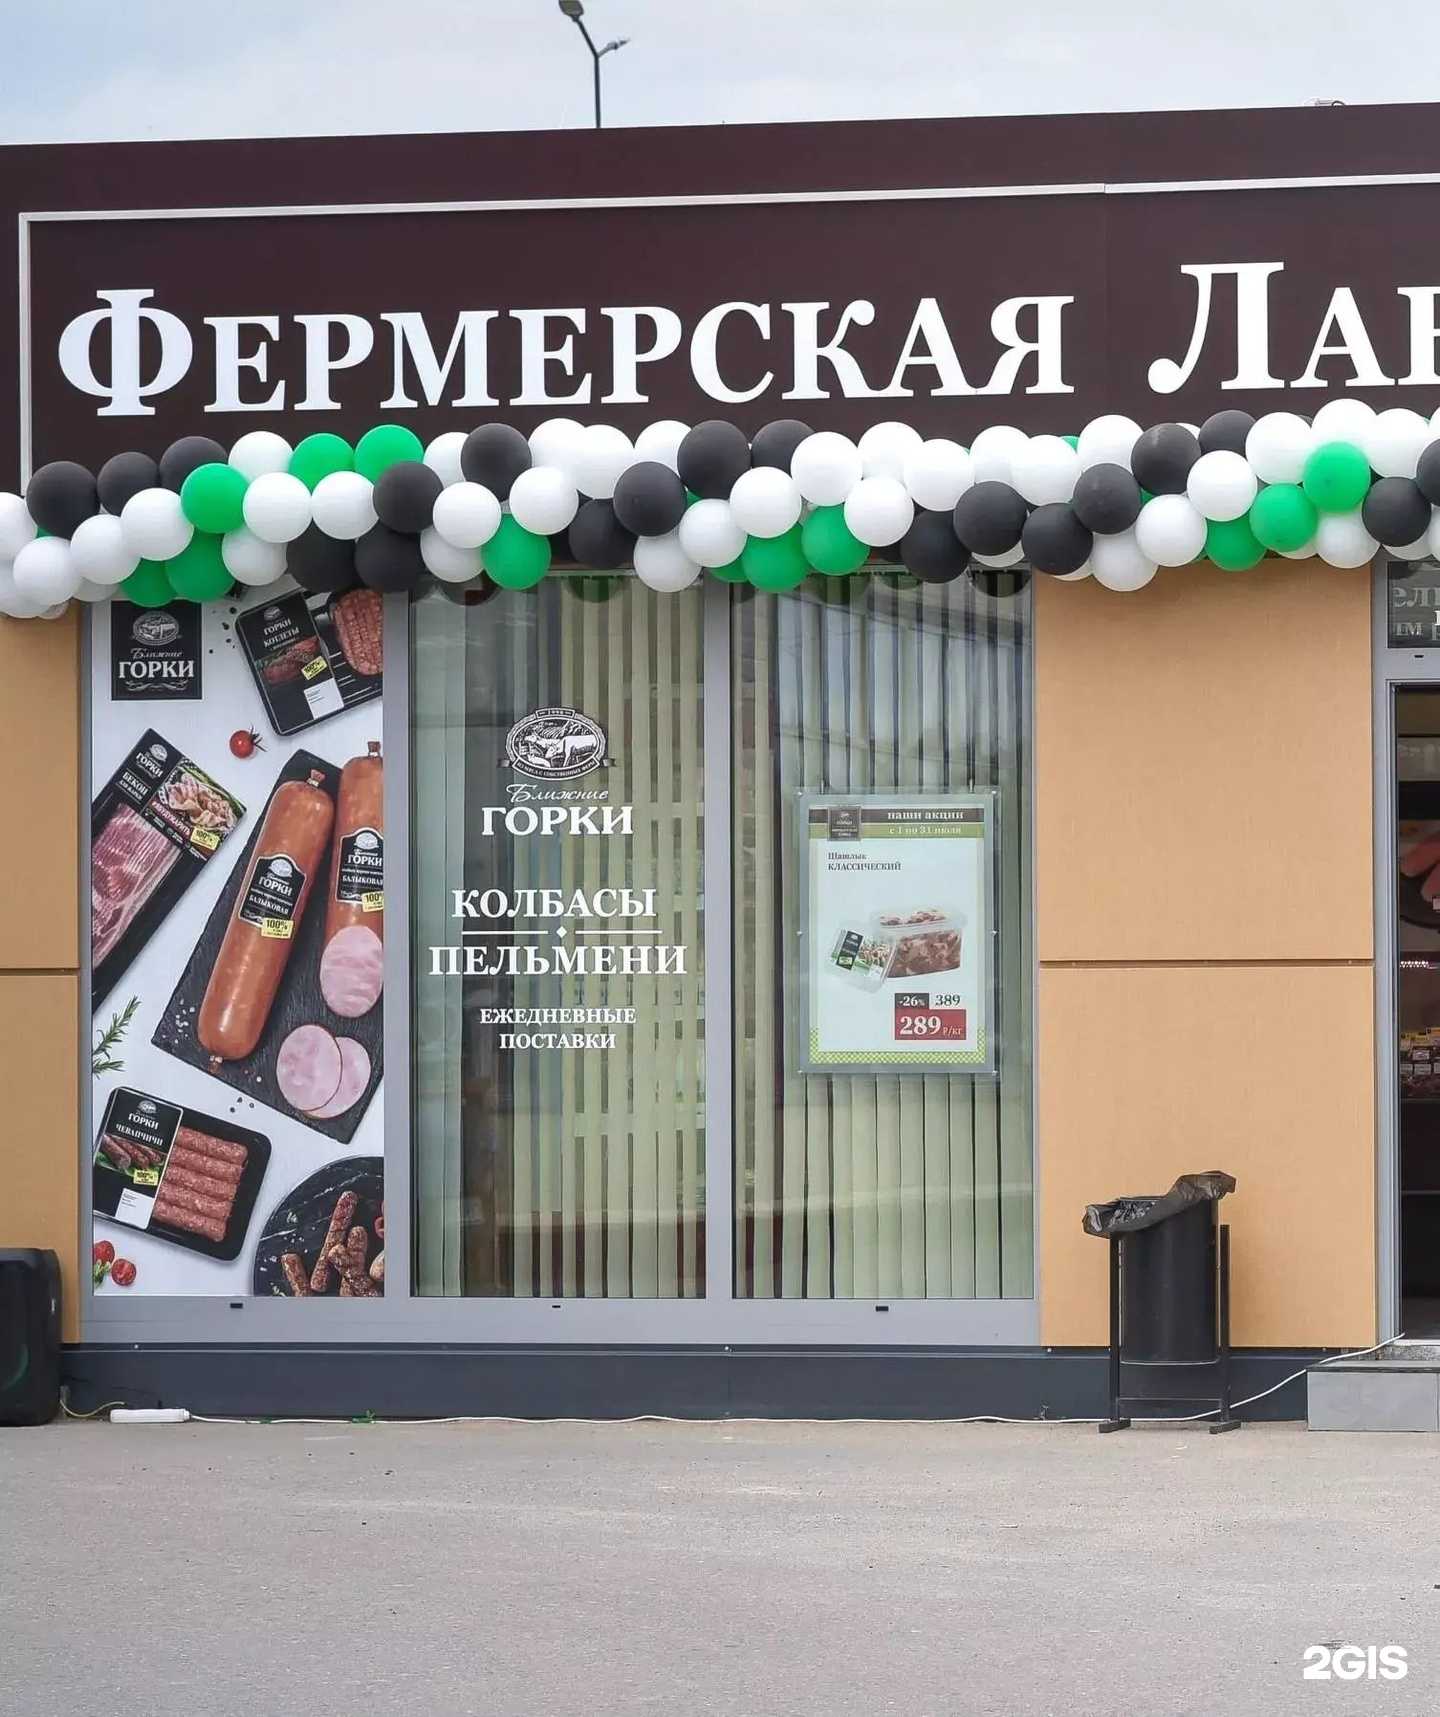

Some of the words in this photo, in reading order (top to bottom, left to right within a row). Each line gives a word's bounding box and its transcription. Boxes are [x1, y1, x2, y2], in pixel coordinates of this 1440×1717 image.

[118, 660, 195, 679] ГОРКИ
[135, 752, 164, 778] ГОРКИ
[122, 771, 149, 796] БЕКОН
[506, 783, 609, 803] Ближние
[481, 806, 633, 836] ГОРКИ
[887, 811, 922, 820] наши
[924, 811, 964, 821] акции
[347, 854, 383, 866] ГОРКИ
[827, 852, 867, 861] Шашлык
[827, 861, 902, 871] КЛАССИЧЕСКИЙ
[258, 876, 293, 896] ГОРКИ
[451, 888, 657, 918] КОЛБАСЫ
[428, 945, 688, 976] ПЕЛЬМЕНИ
[899, 995, 926, 1007] -26%
[935, 994, 961, 1007] 389
[479, 1008, 637, 1027] ЕЖЕДНЕВНЫЕ
[900, 1015, 942, 1036] 289
[499, 1033, 616, 1050] ПОСТАВКИ
[128, 1112, 159, 1130] ГОРКИ
